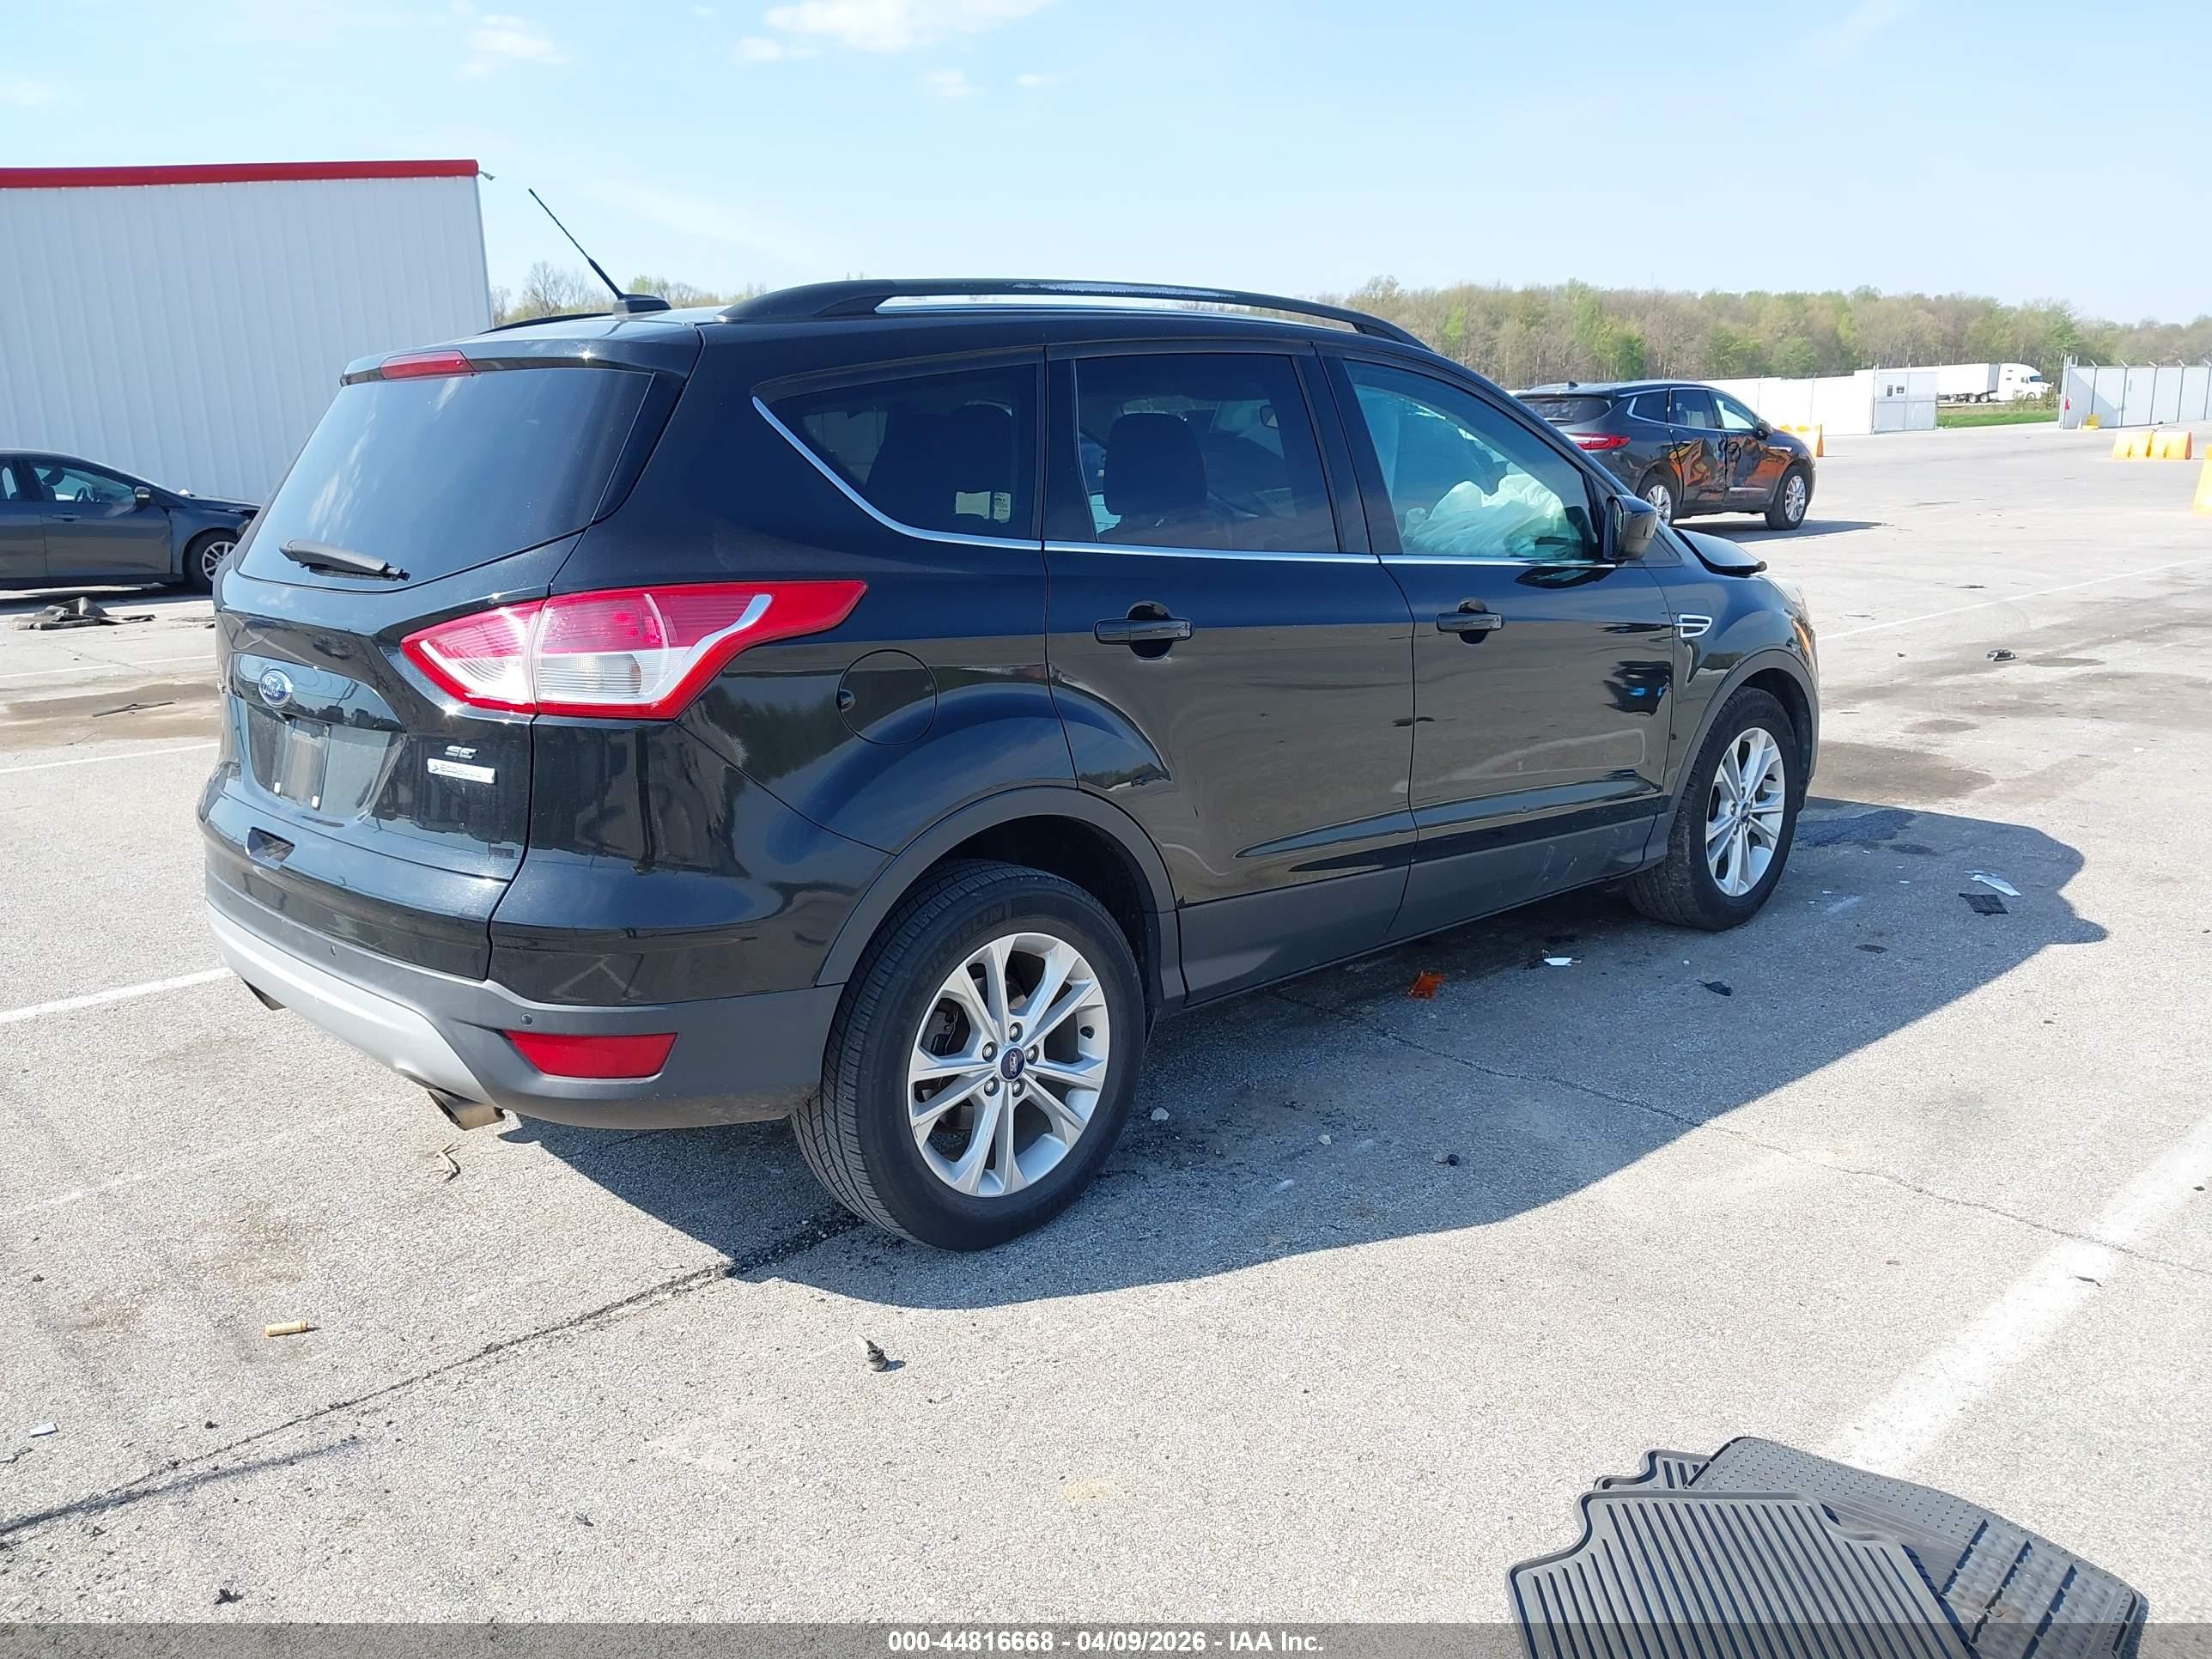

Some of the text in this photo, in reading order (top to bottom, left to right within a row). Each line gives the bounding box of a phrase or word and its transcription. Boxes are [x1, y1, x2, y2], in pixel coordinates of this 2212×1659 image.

[262, 676, 282, 696] Ford
[445, 745, 477, 759] SE
[440, 763, 487, 779] ECOB
